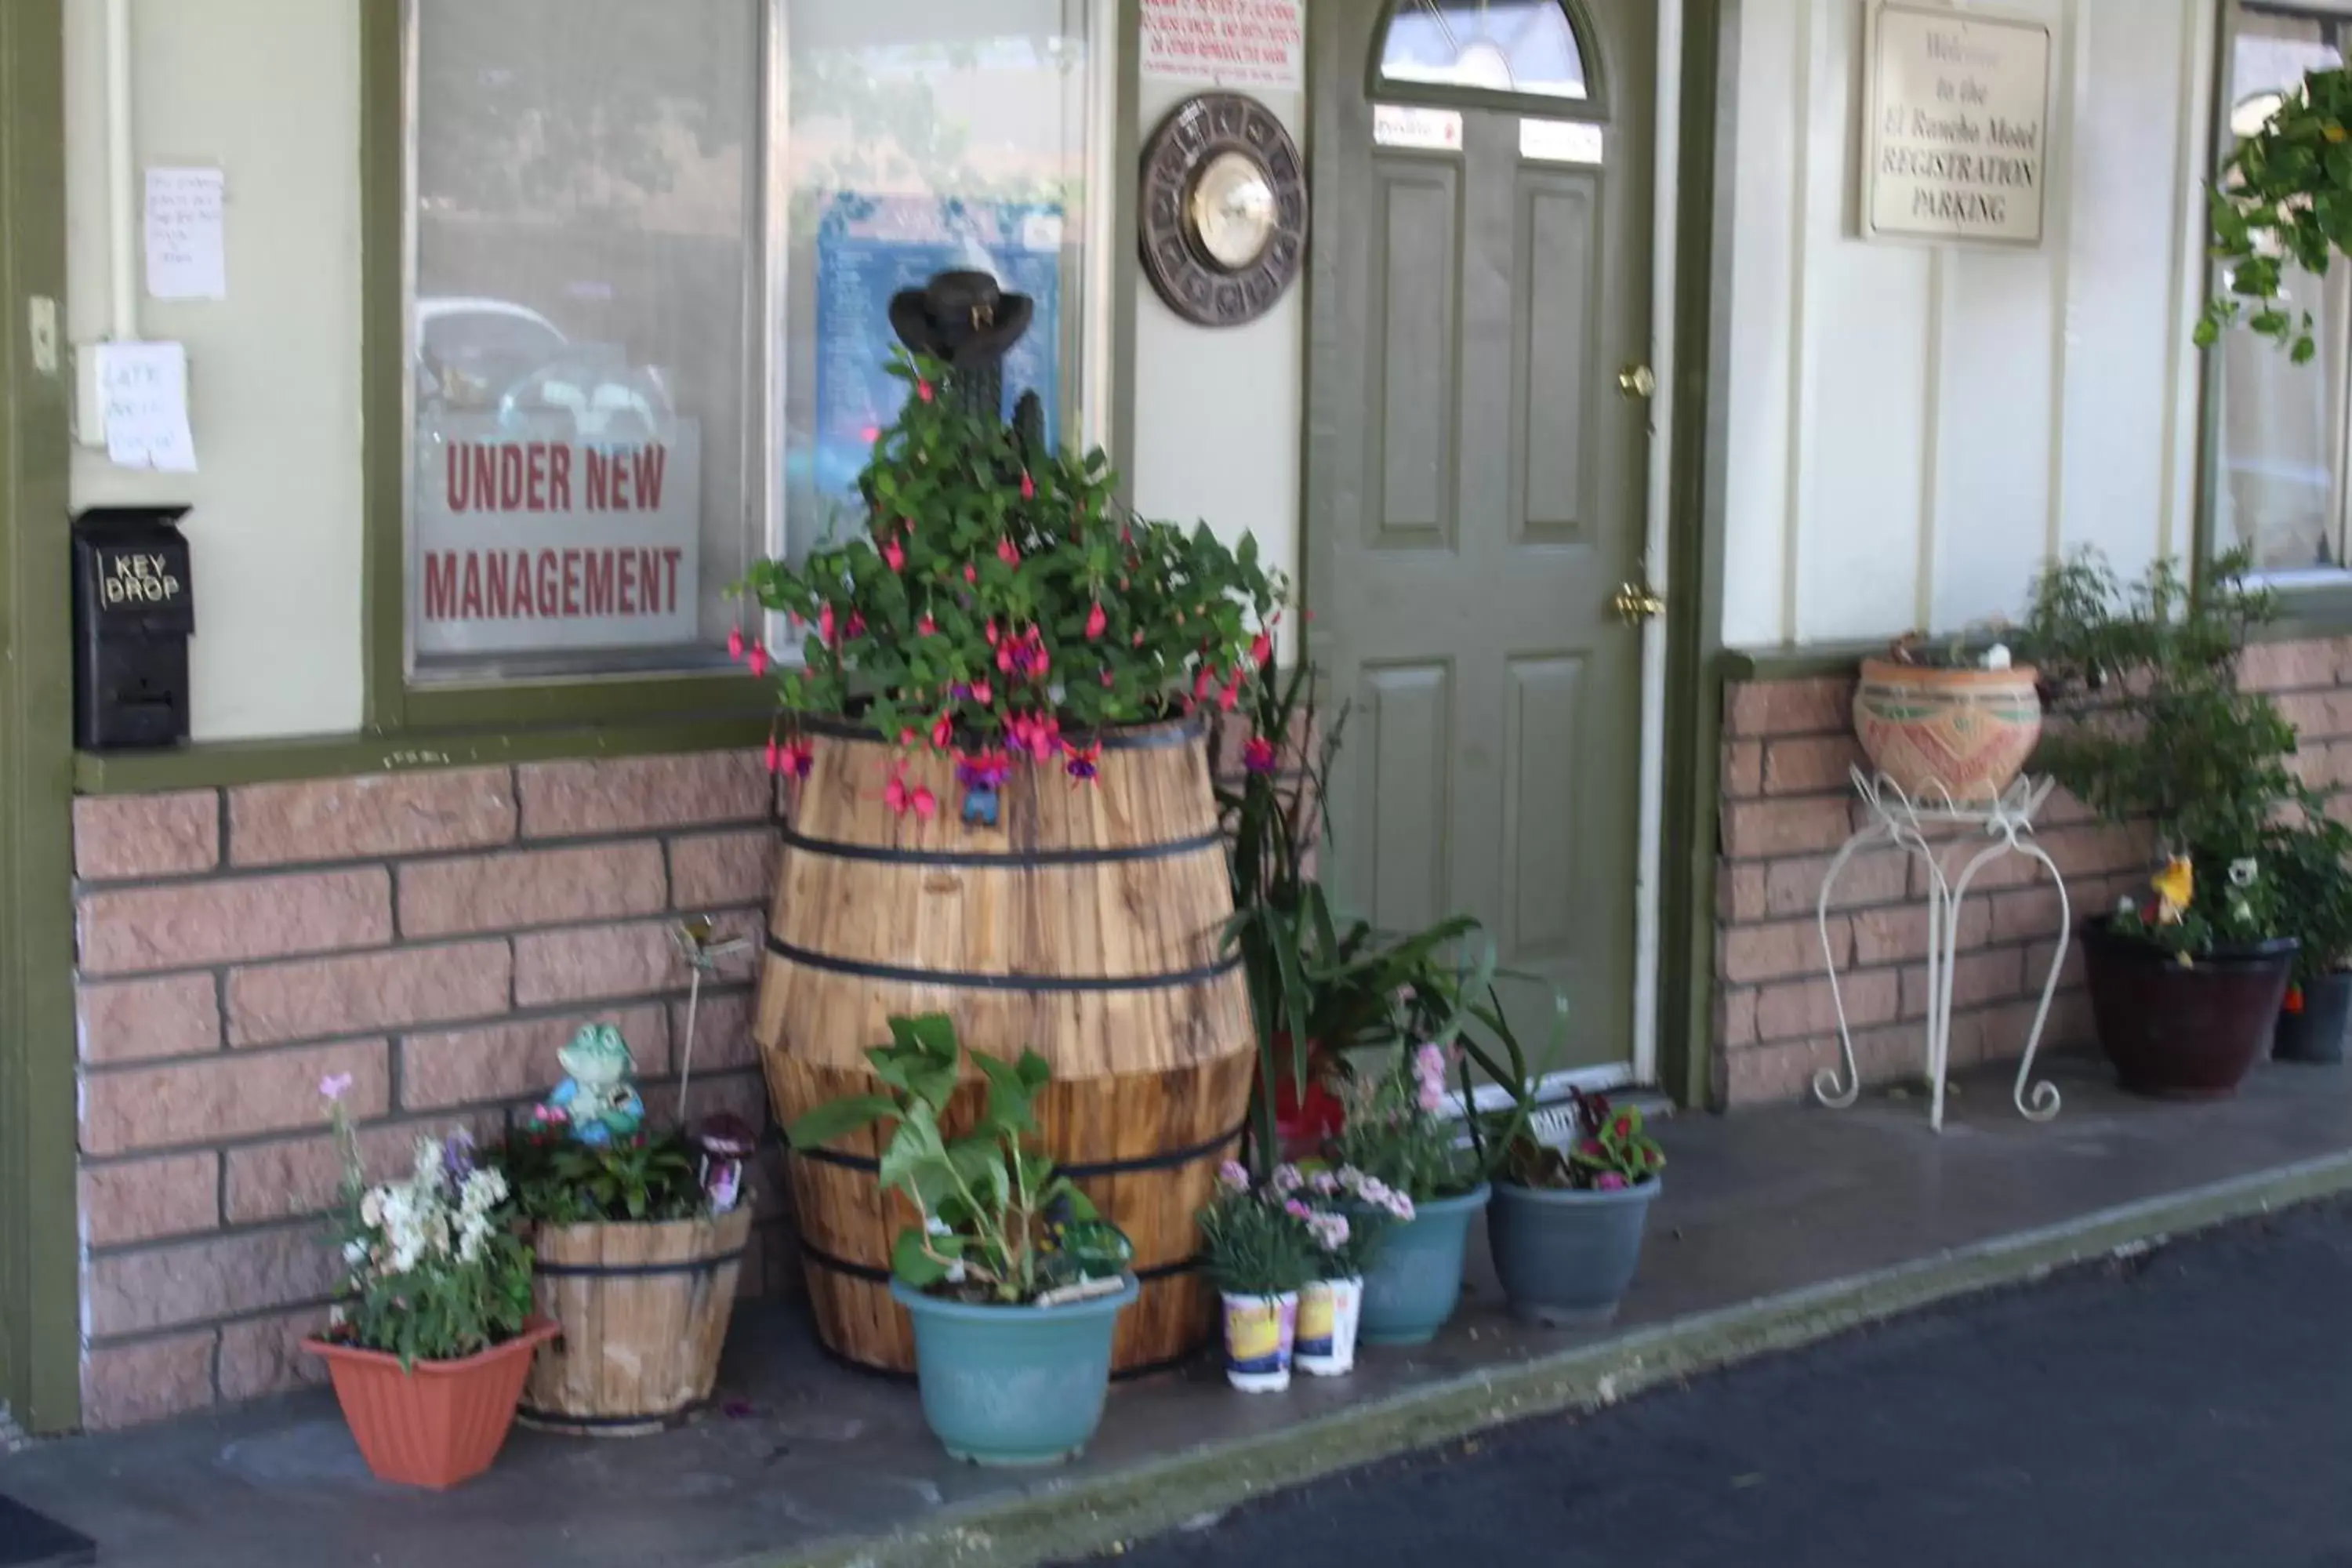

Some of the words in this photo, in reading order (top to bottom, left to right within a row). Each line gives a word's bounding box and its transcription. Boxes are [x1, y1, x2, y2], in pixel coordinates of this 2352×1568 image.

[1926, 30, 2002, 69] Welc
[1936, 76, 1955, 102] to
[1960, 77, 1989, 106] the
[1986, 116, 2038, 151] Motel
[1882, 147, 2037, 189] REGISTRATION
[1911, 187, 2007, 225] PARKING
[446, 441, 573, 513] UNDER
[585, 441, 666, 512] NEW
[114, 553, 166, 579] KEY
[424, 546, 683, 621] MANAGEMENT
[106, 575, 180, 602] DROP
